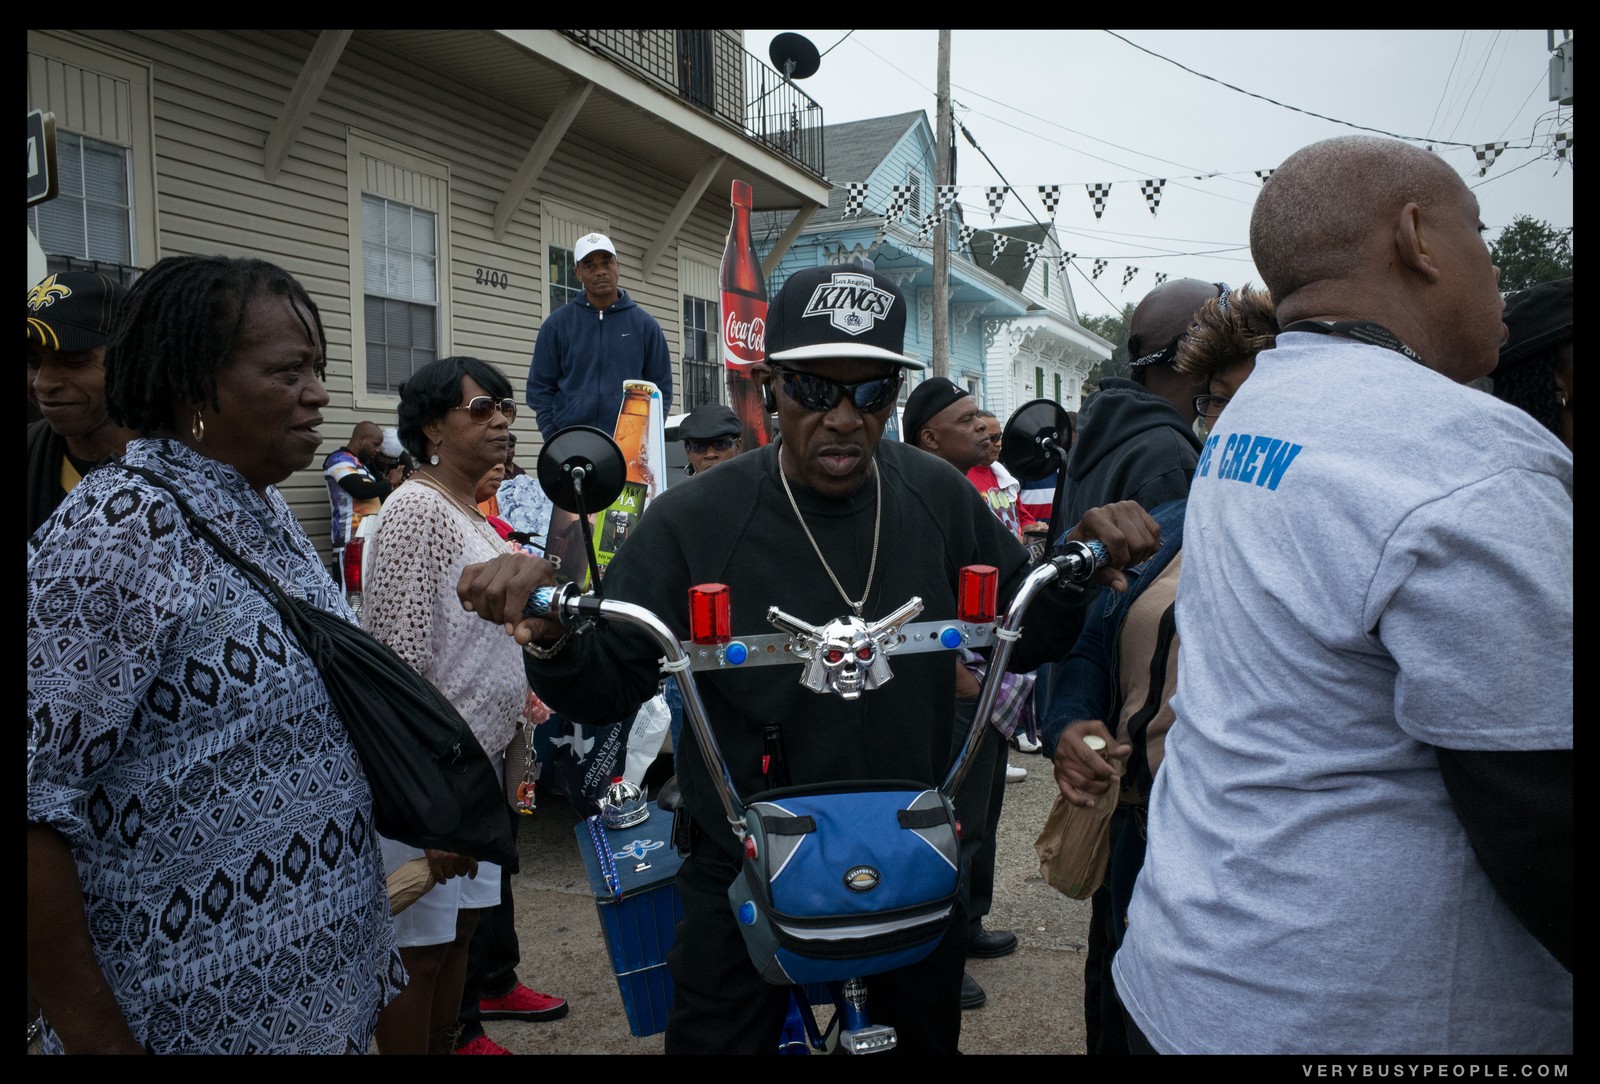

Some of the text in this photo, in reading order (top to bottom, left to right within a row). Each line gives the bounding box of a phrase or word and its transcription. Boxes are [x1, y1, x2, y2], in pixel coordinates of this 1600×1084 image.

[475, 268, 508, 290] 2100
[847, 278, 871, 289] Angeles
[809, 286, 889, 315] KINGS
[726, 311, 766, 353] Coca-Col
[1218, 433, 1303, 491] CREW
[580, 749, 607, 797] AERICAN
[591, 740, 621, 787] OUTFITTERS
[847, 868, 878, 880] CALIFORNIA
